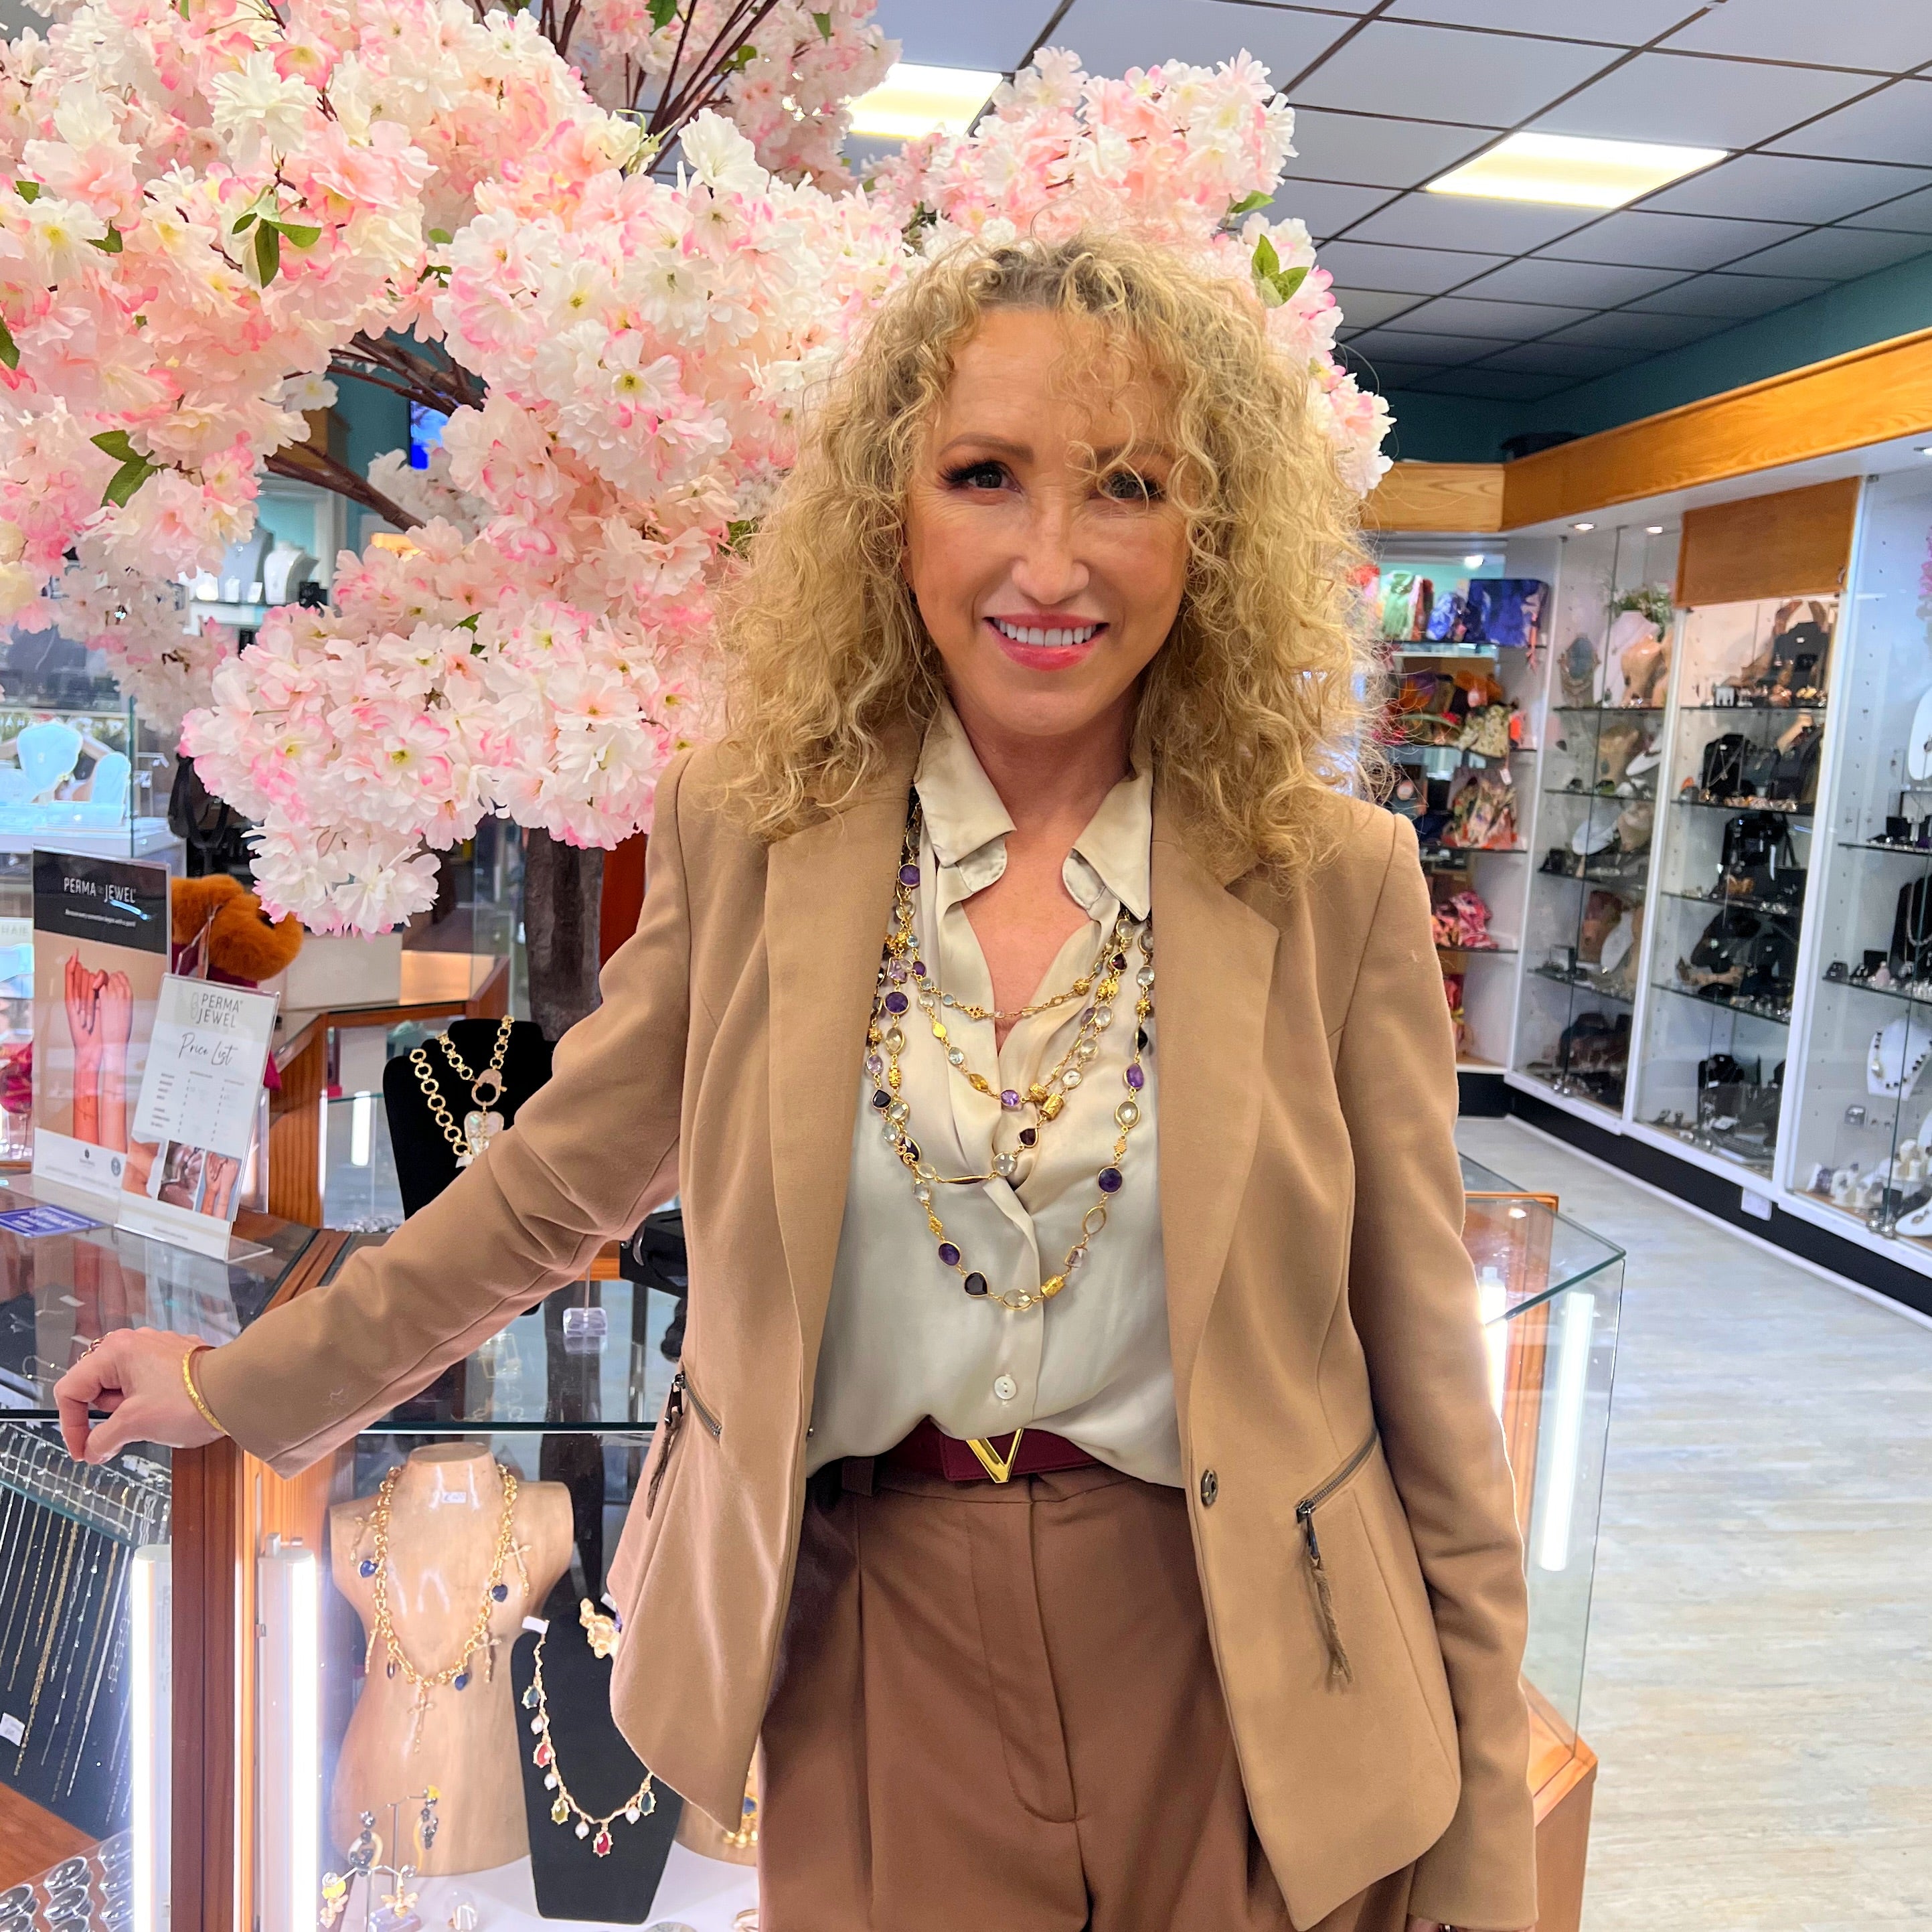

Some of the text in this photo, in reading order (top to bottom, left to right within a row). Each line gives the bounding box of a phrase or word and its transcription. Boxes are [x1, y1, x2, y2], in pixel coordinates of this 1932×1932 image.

[64, 877, 135, 904] PERMA JEWEL
[202, 993, 240, 1013] PERMA
[195, 1008, 236, 1028] JEWEL
[178, 1032, 238, 1066] Price List
